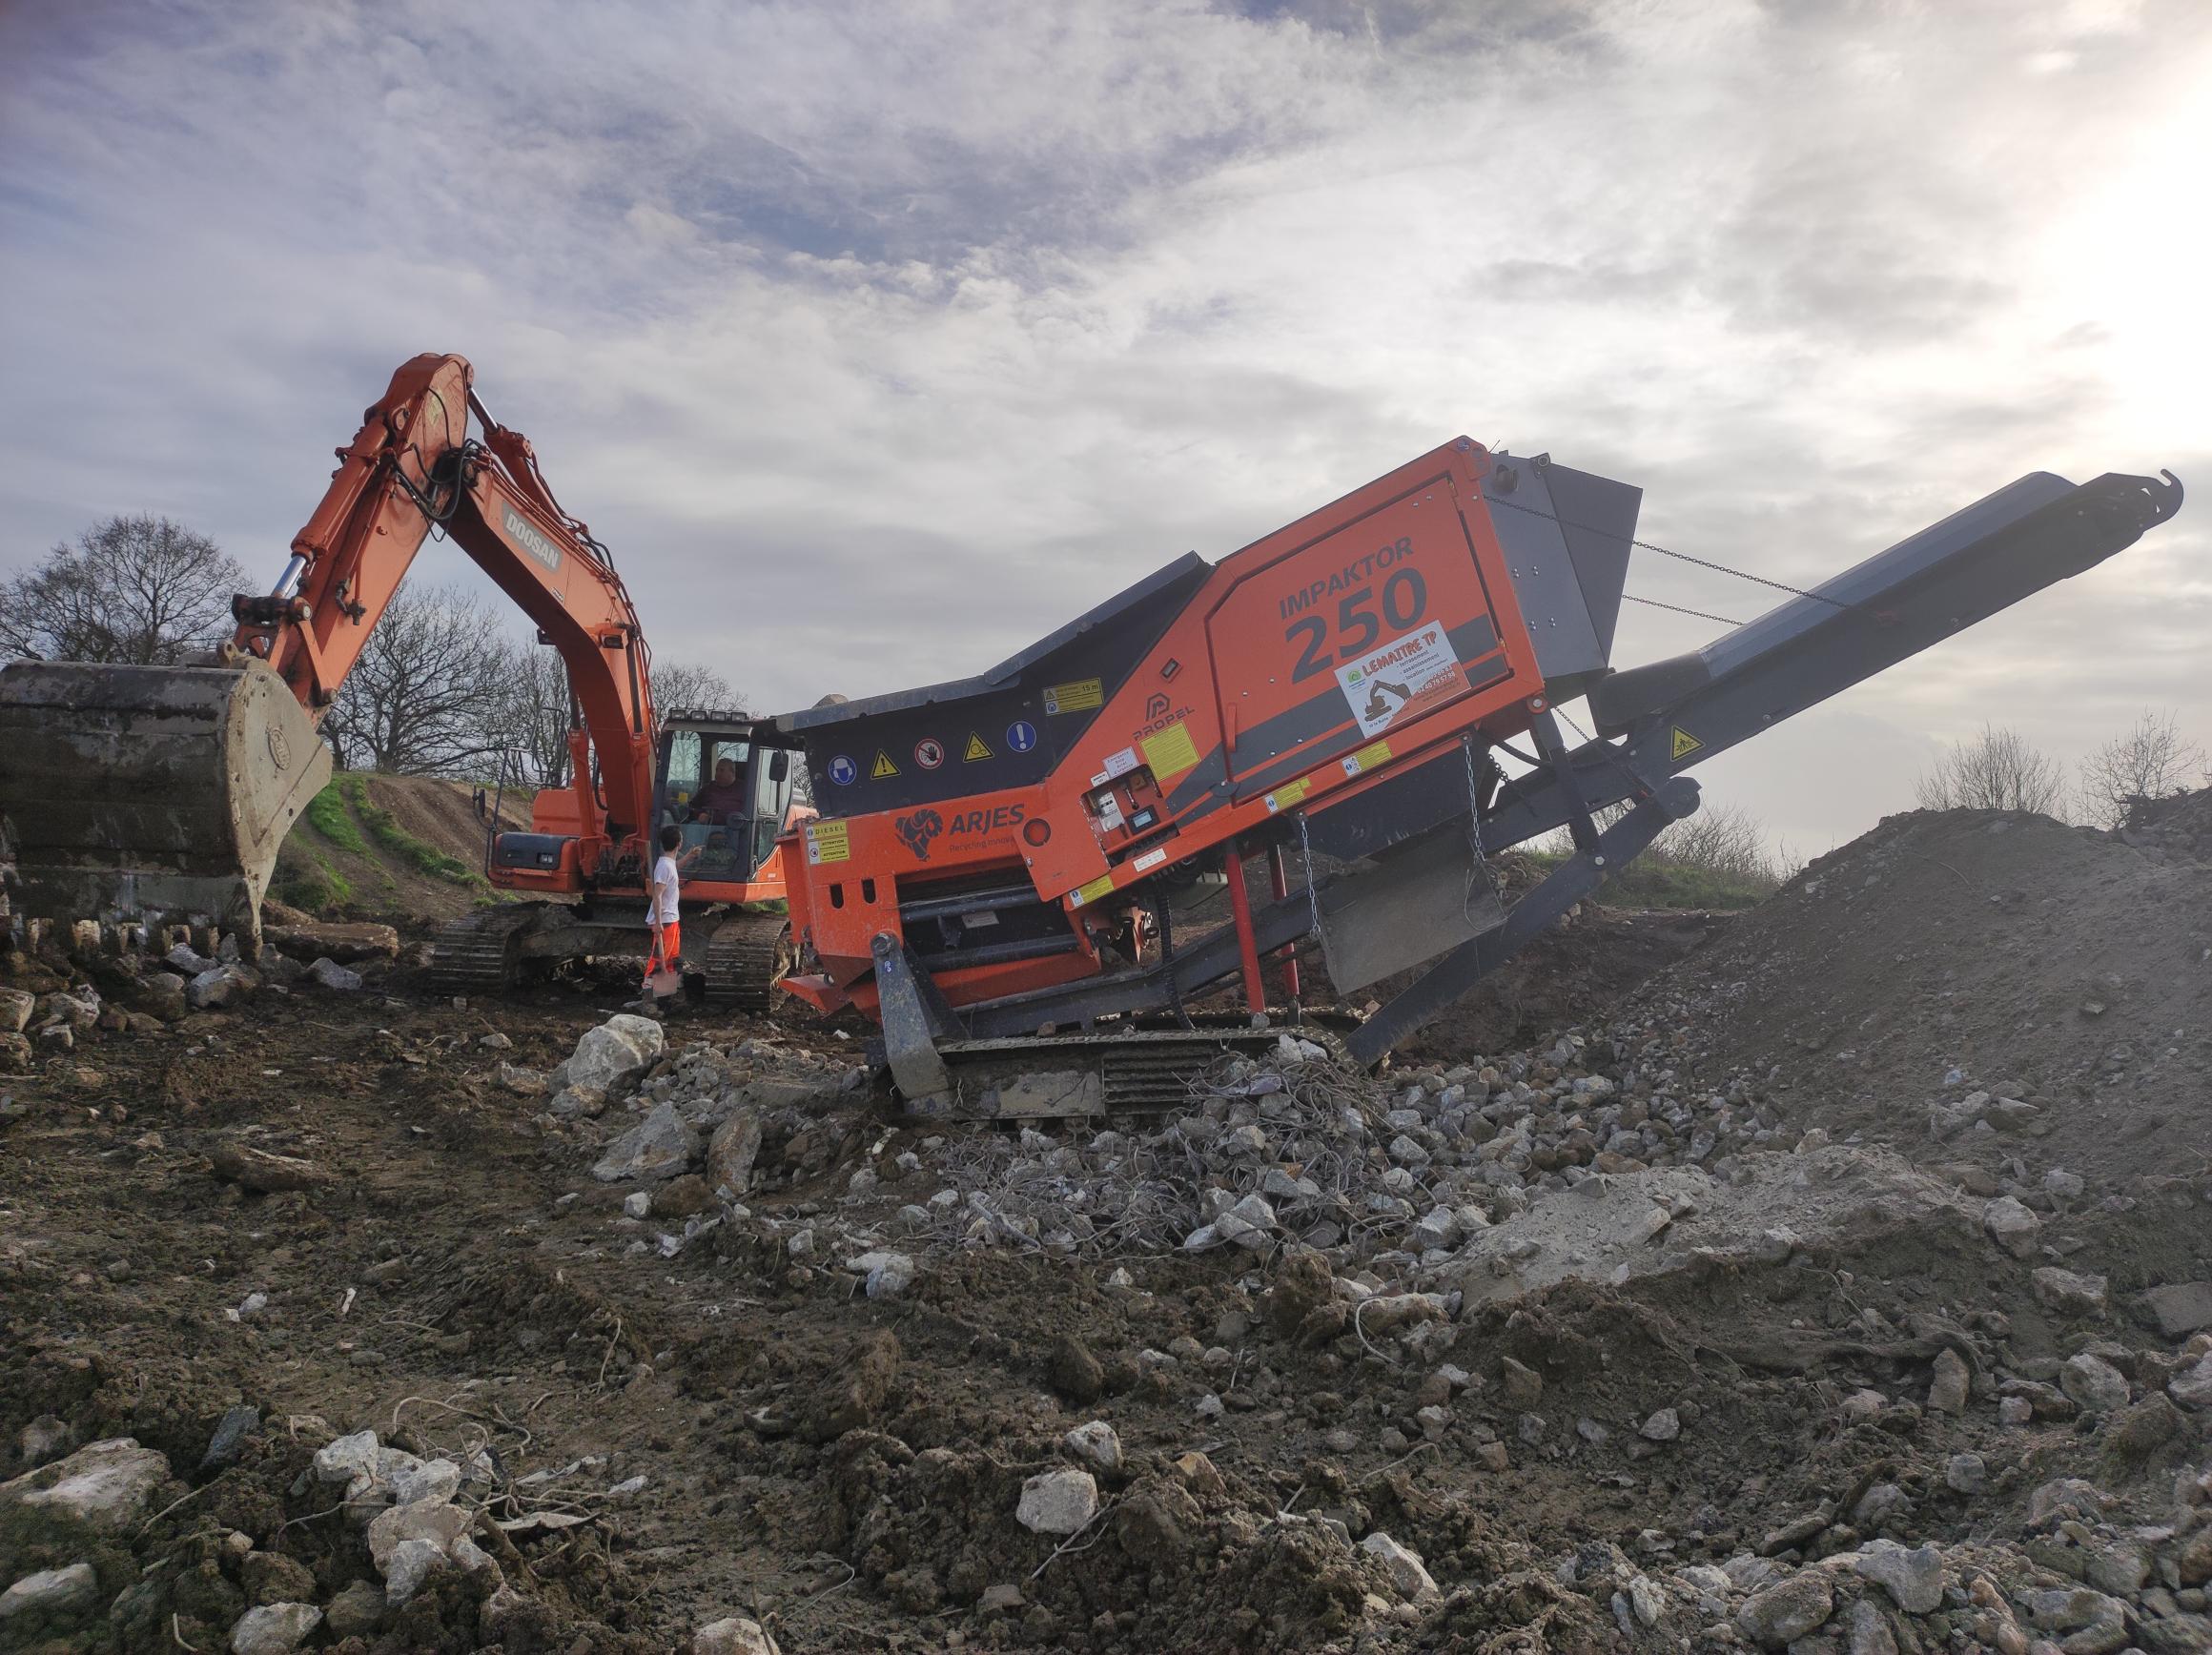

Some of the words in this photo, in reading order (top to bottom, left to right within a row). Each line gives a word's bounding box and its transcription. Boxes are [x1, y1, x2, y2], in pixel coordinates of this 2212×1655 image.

[505, 513, 559, 568] DOOSAN
[1279, 537, 1414, 620] IMPAKTOR
[1285, 567, 1427, 684] 250
[1362, 638, 1423, 677] LEMAITRE
[1422, 631, 1436, 646] TP
[1133, 706, 1196, 741] PROPEL
[815, 826, 845, 835] DIESEL
[950, 804, 1025, 835] ARJES
